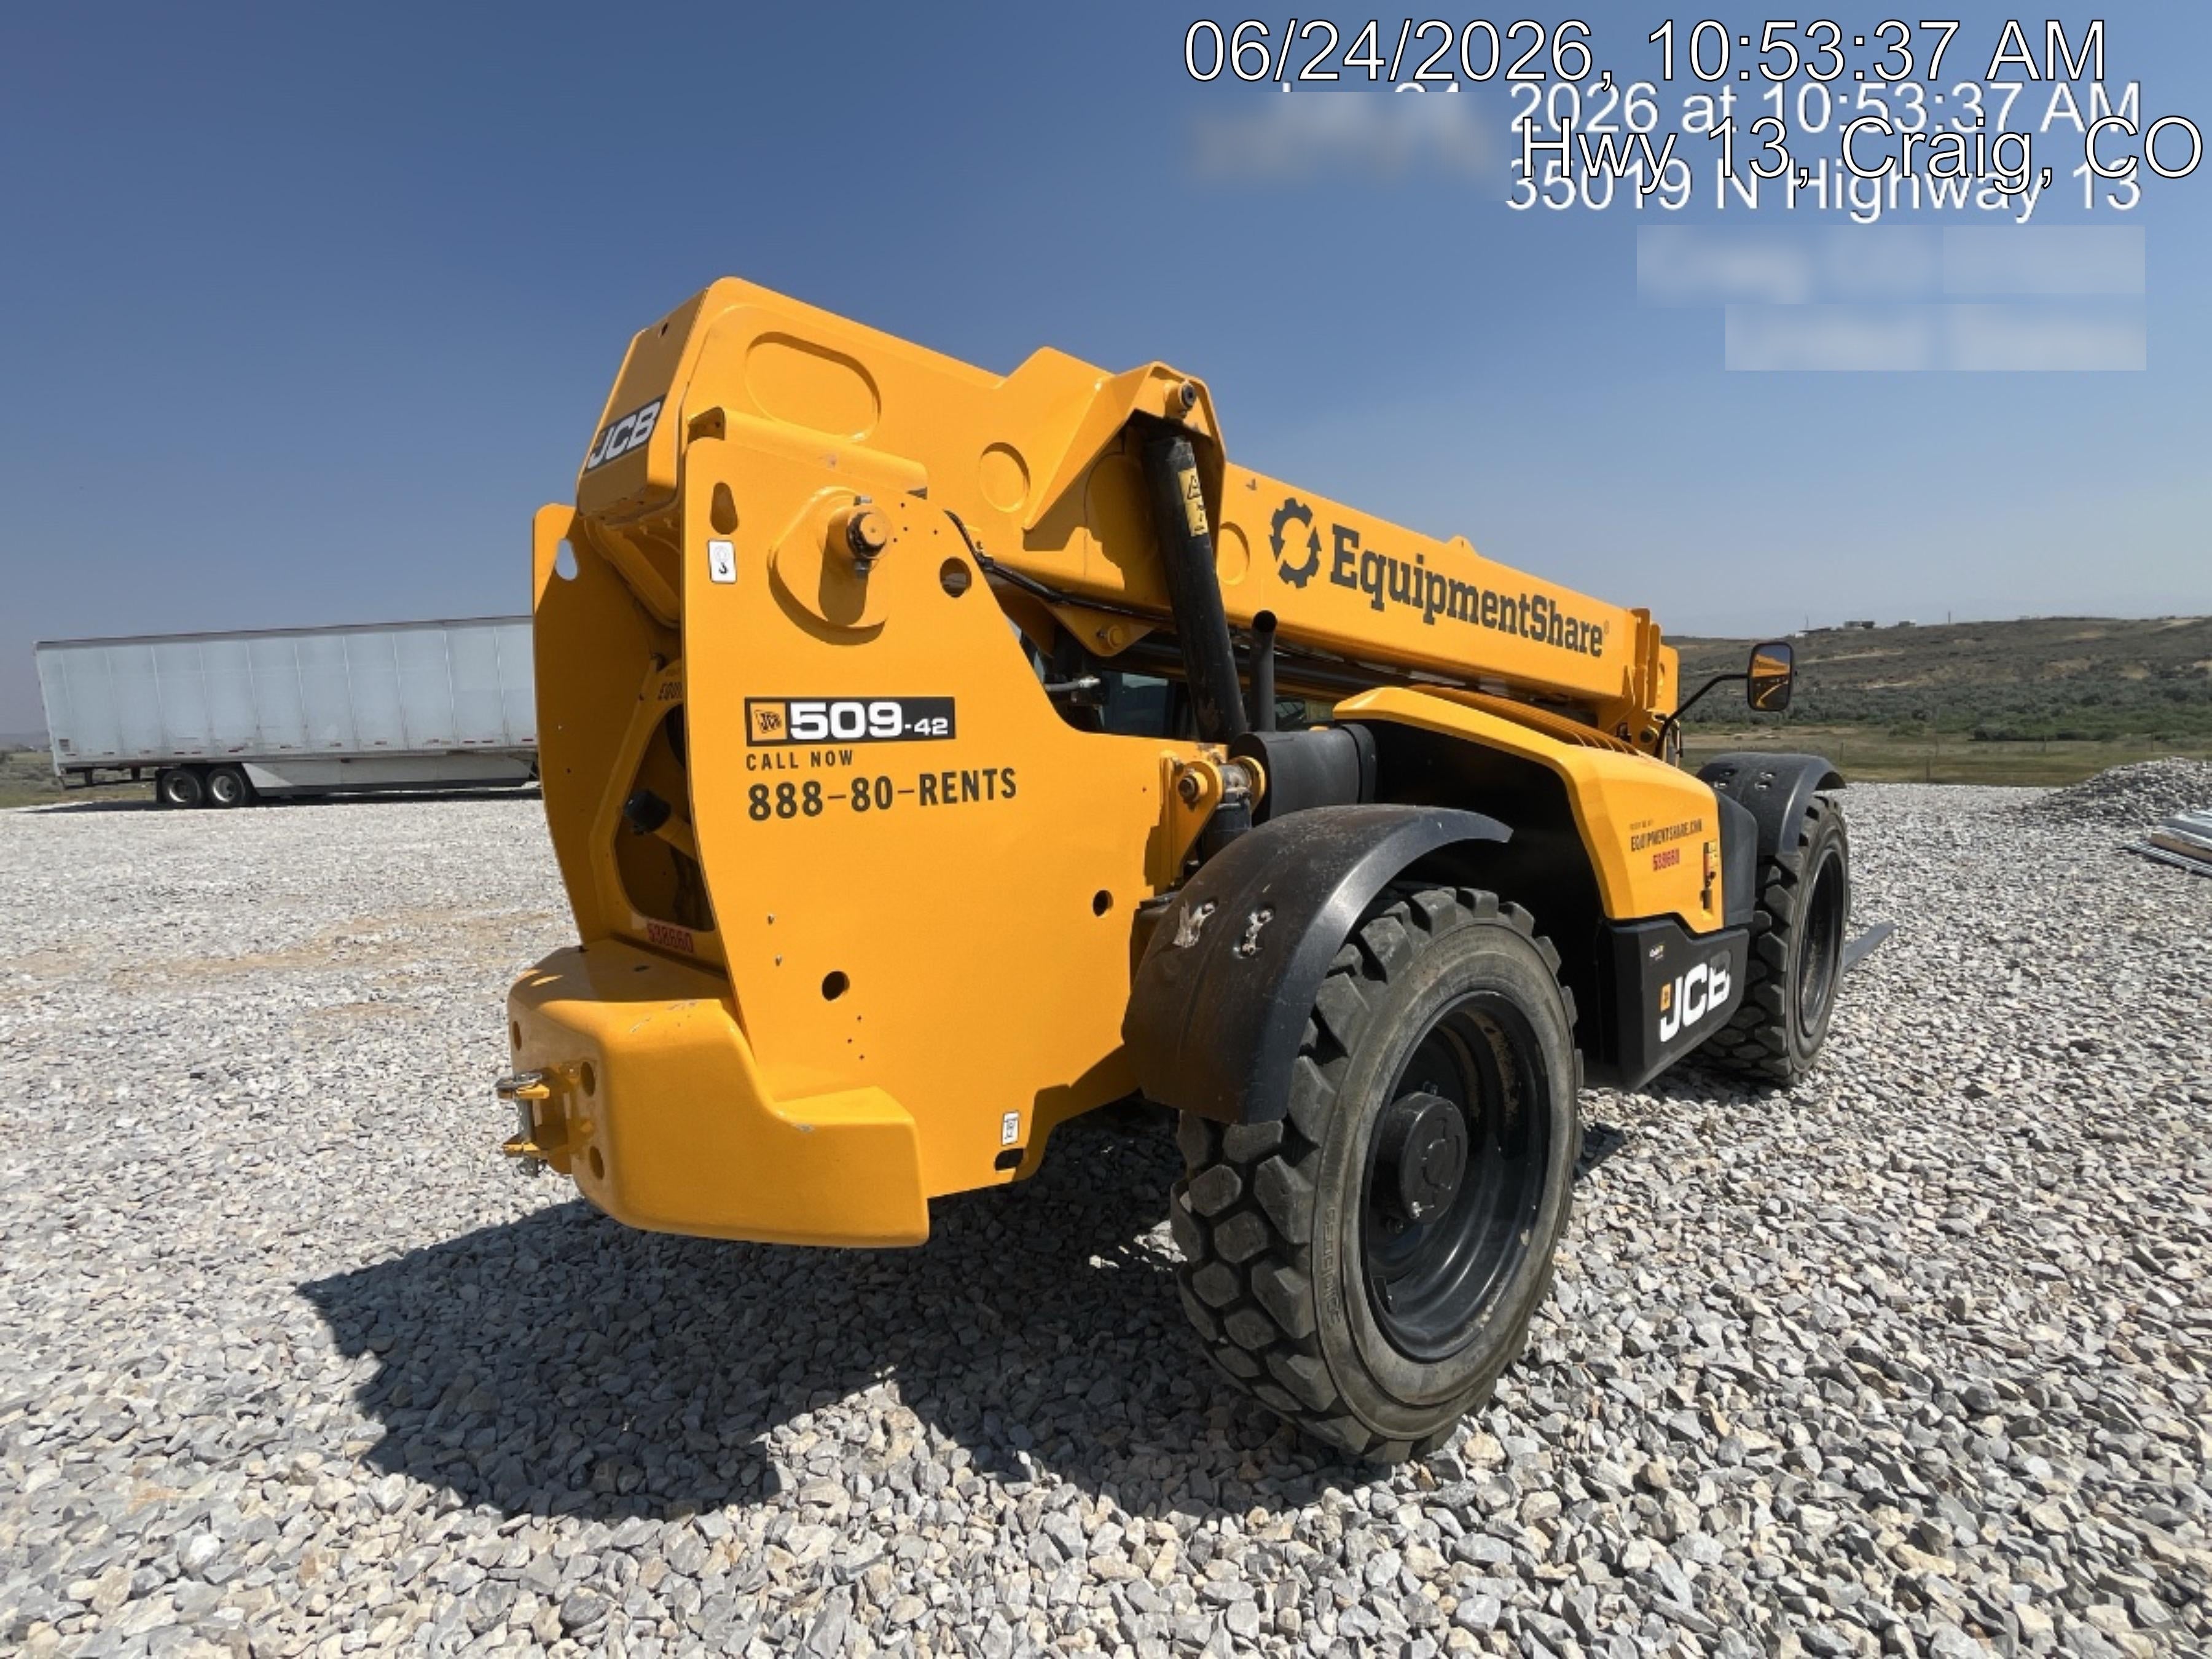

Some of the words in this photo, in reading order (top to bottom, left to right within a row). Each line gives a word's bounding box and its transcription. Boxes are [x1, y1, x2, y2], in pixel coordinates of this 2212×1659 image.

[587, 401, 661, 469] JCB
[1330, 523, 1603, 658] EquipmentShare
[746, 752, 799, 771] CALL
[810, 750, 853, 767] NOW
[748, 767, 1016, 821] 888-80-RENTS
[1660, 952, 1732, 1042] JCB
